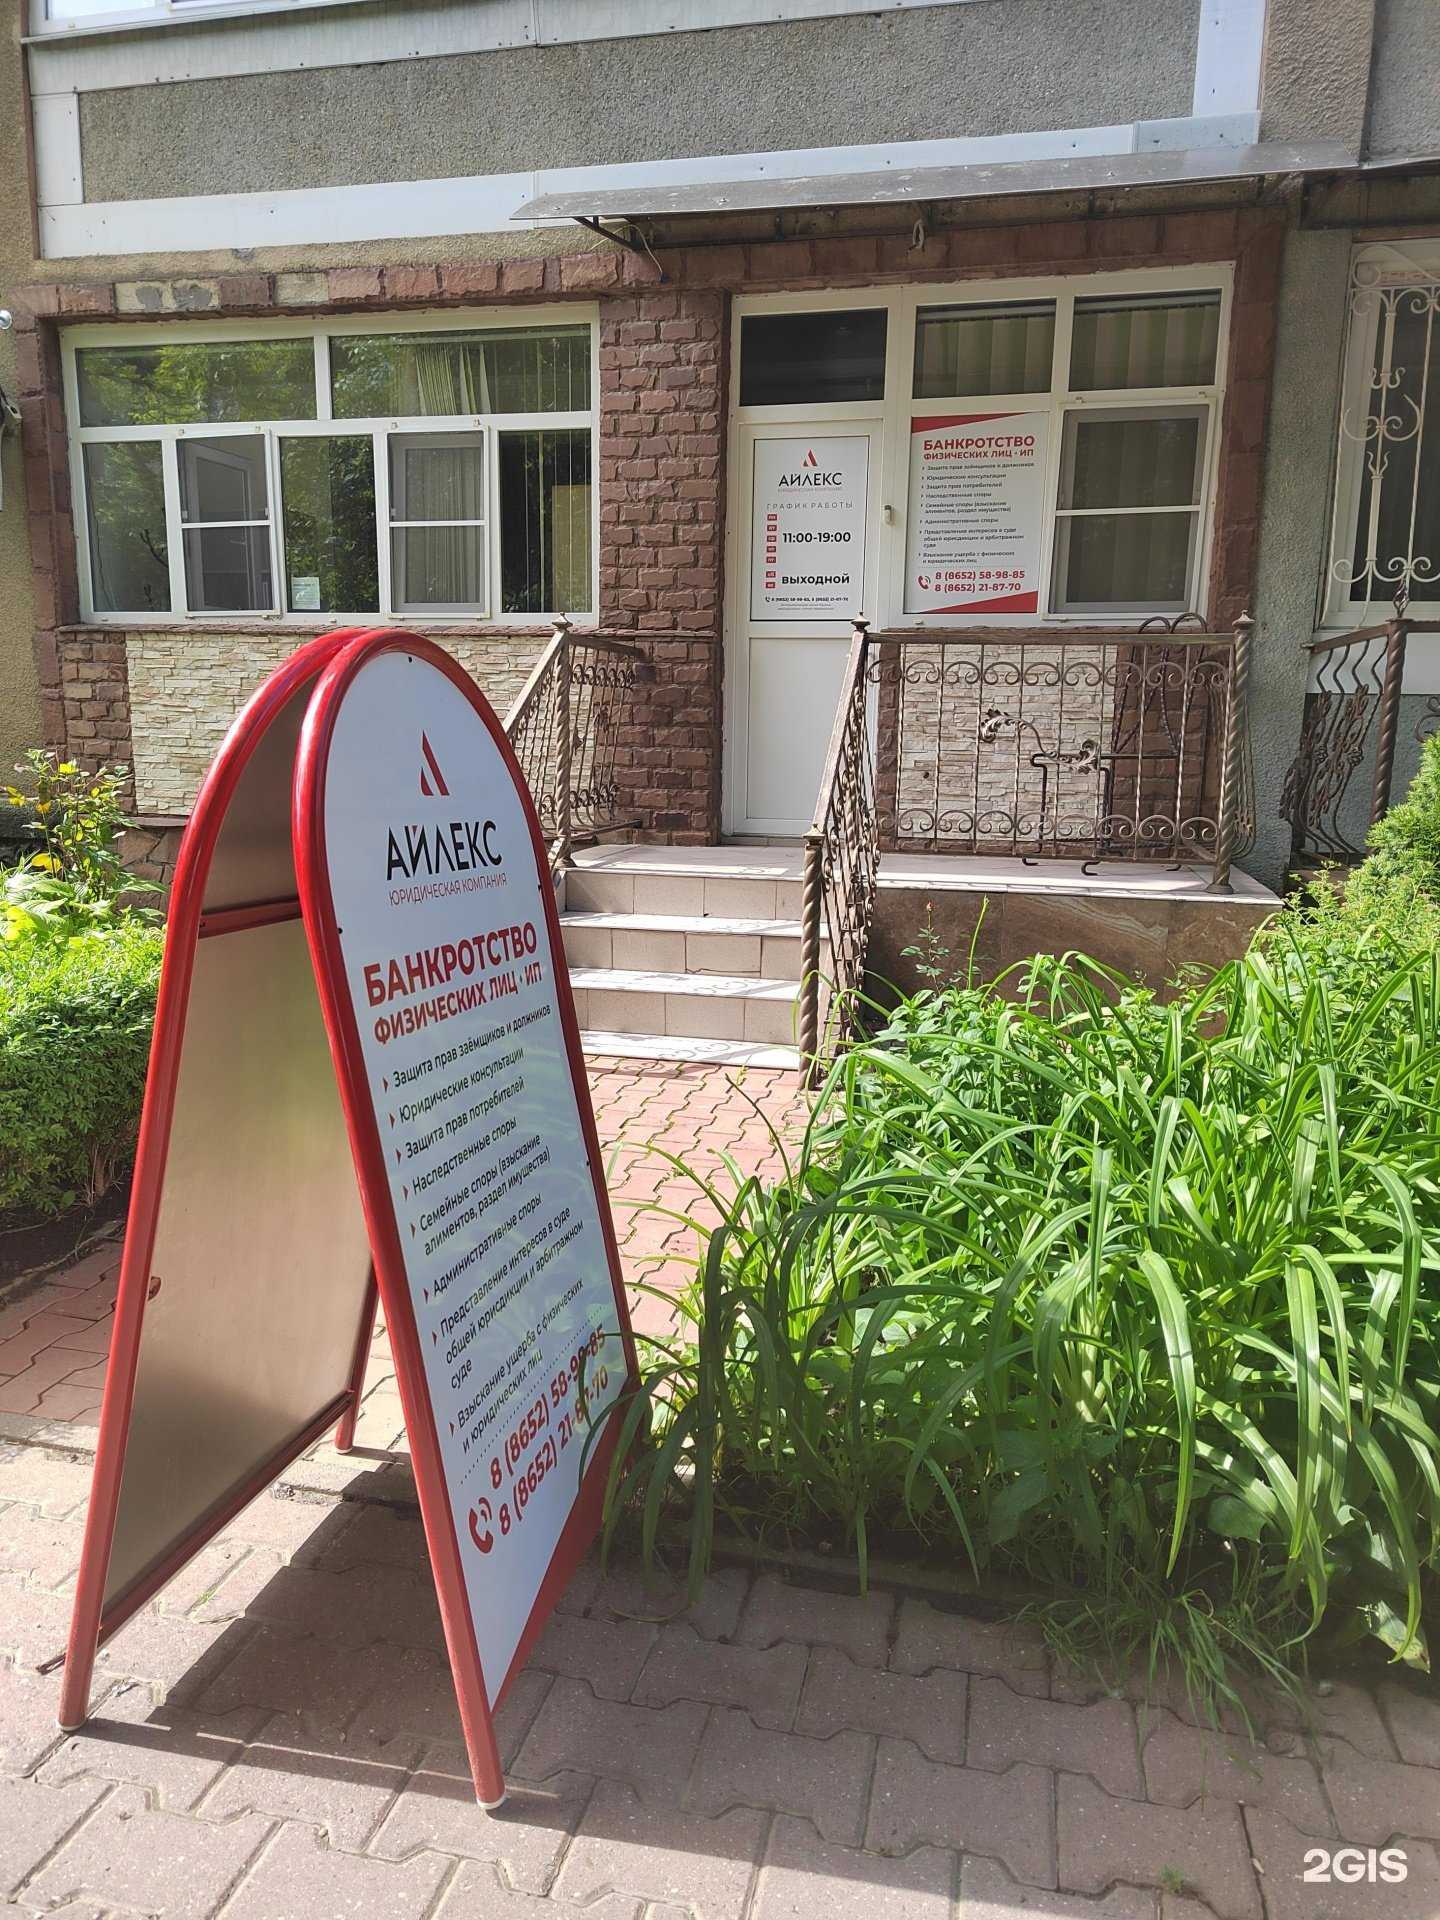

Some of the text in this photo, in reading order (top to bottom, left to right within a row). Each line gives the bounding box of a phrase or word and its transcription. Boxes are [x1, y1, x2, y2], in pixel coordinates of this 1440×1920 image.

[779, 472, 842, 487] АЙЛЕКС
[924, 436, 1036, 450] БАНКРОТСТВО
[924, 449, 1034, 460] ФИЗИЧЕСКИХ ЛИЦ ИП
[783, 532, 851, 543] 11:00-19:00
[811, 501, 853, 509] РАБОТЫ
[935, 583, 1021, 593] 8 (8652) 21-87-70
[936, 571, 1025, 581] 8 (8652) 58-98-85
[386, 820, 502, 881] АЙЛЕКС
[389, 872, 507, 907] ЮРИДИЧЕСКАЯ КОМПАНИЯ
[363, 921, 538, 1007] БАНКРОТСТВО
[374, 962, 543, 1045] ФИЗИЧЕСКИХ ЛИЦ ИП
[393, 1005, 551, 1088] Защита прав заёмщиков и должников
[400, 1047, 524, 1124] Юридические консультации
[406, 1076, 525, 1159] Защита прав потребителей
[412, 1116, 517, 1196] Наследственные споры
[420, 1133, 542, 1232] Семейные споры (взыскание
[424, 1146, 551, 1256] алиментов, раздел имущества)
[433, 1193, 543, 1296] Административные споры
[440, 1207, 571, 1337] Представление интересов в суде
[446, 1220, 584, 1365] общей юрисдикции и арбитражном
[451, 1358, 473, 1390] суде
[457, 1278, 584, 1429] Взыскание ущерба с физических
[462, 1348, 544, 1454] и юридических лиц
[490, 1457, 503, 1490] 8
[505, 1393, 549, 1476] (8652)
[500, 1503, 511, 1535] 8
[513, 1435, 558, 1521] (8652)
